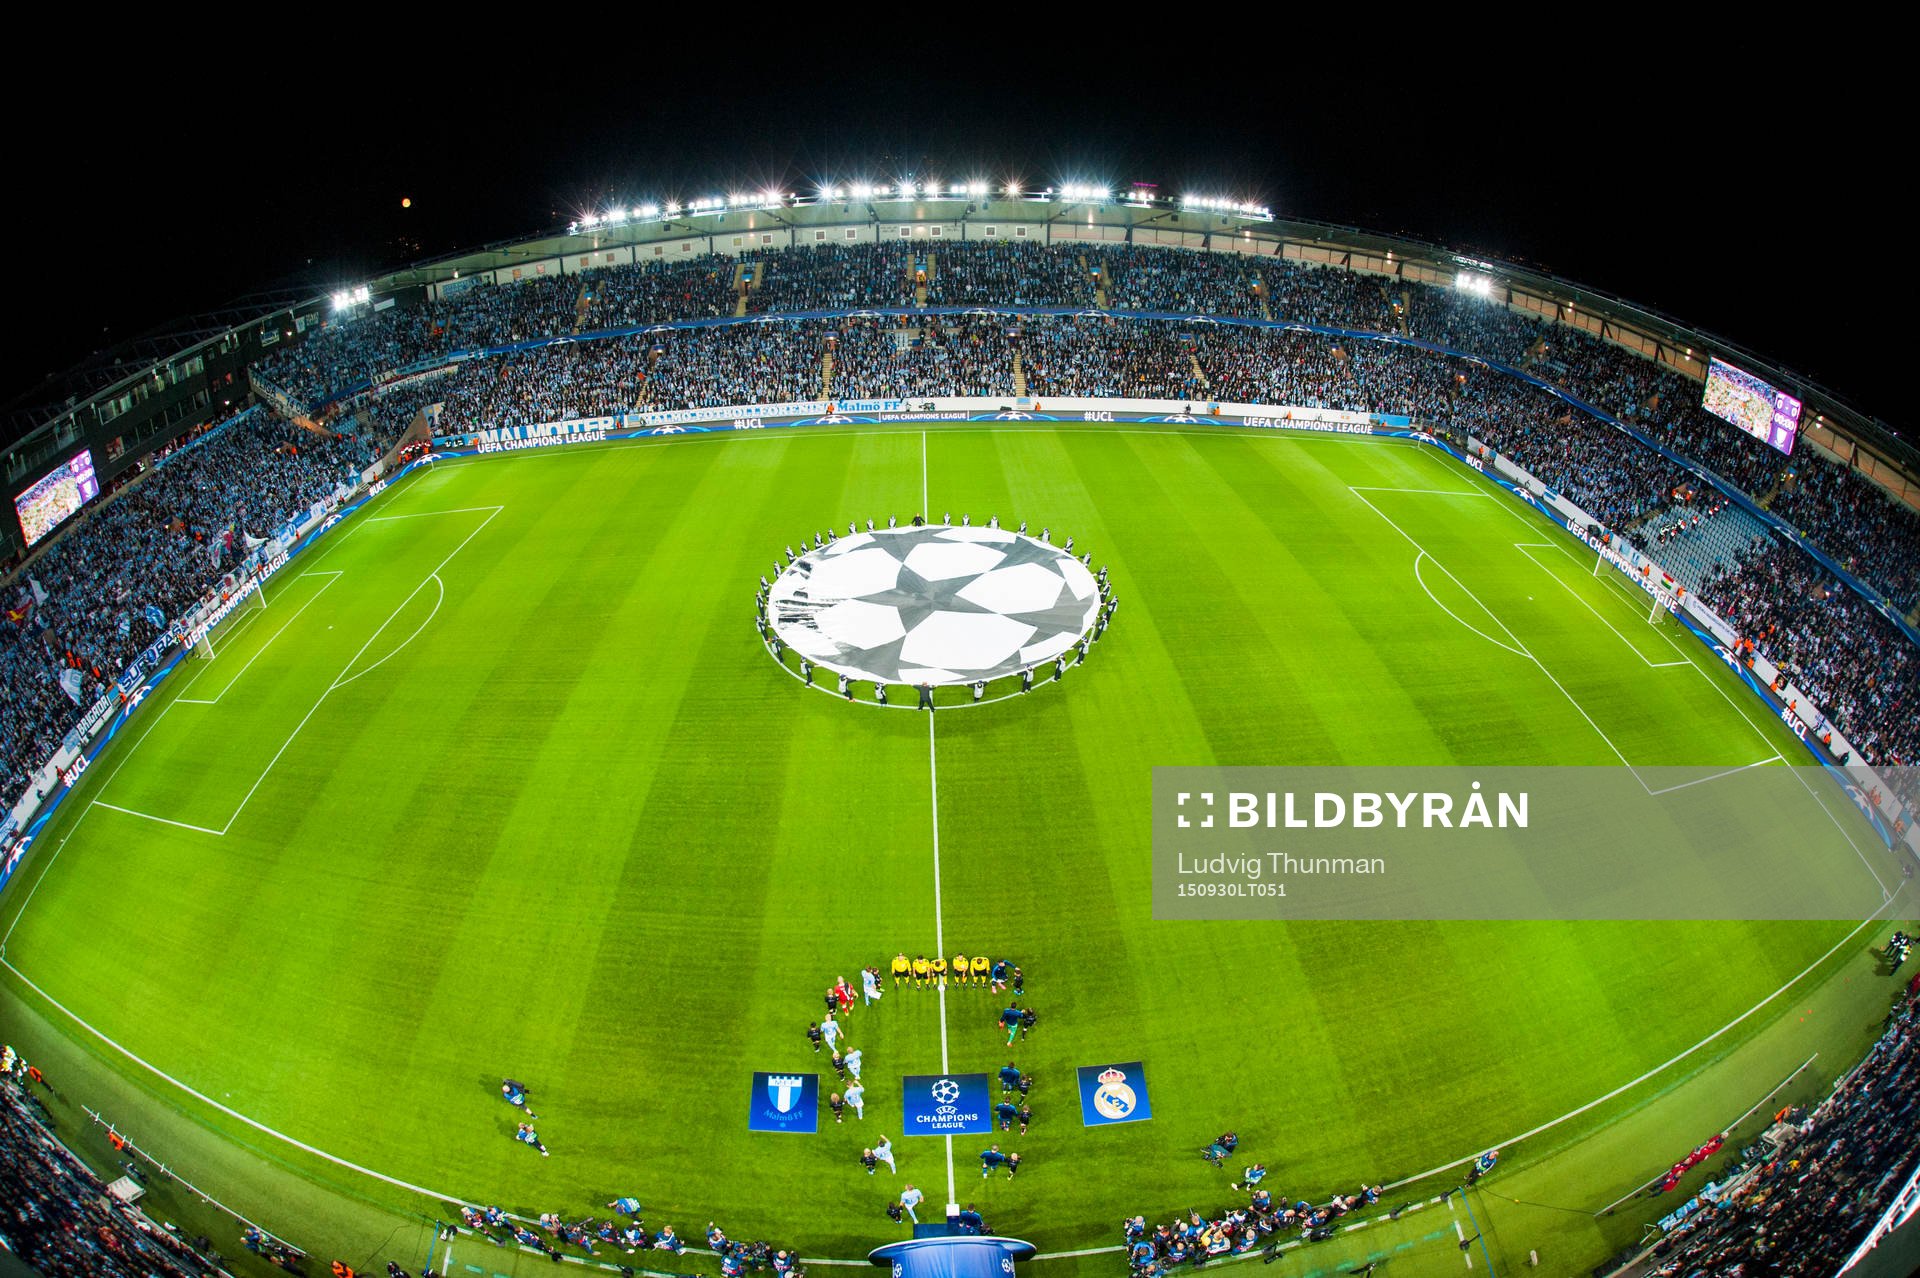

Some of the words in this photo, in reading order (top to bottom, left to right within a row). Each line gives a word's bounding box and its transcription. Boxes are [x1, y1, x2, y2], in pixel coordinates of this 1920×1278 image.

[837, 401, 881, 412] Malmö
[883, 401, 901, 411] FF
[733, 418, 765, 430] #UCL
[881, 413, 899, 421] UEFA
[900, 413, 940, 421] CHAMPIONS
[941, 412, 966, 420] LEAGUE
[1083, 410, 1115, 423] #UCL
[1243, 416, 1272, 429] UEFA
[1274, 418, 1334, 433] CHAMPIONS
[1337, 421, 1373, 435] LEAGUE
[477, 441, 503, 454] UEFA
[504, 435, 563, 452] CHAMPIONS
[565, 430, 606, 444] LEAGUE
[1465, 454, 1484, 473] #UCL
[369, 479, 388, 497] #UCL
[1566, 519, 1588, 543] UEFA
[1589, 536, 1640, 583] CHAMPIONS
[1641, 577, 1678, 613] LEAGUE
[184, 622, 211, 650] UEFA
[211, 576, 259, 624] CHAMPIONS
[259, 549, 291, 583] LEAGUE
[1781, 706, 1808, 742] #UCL
[63, 754, 91, 788] #UCL
[916, 1113, 979, 1123] CHAMPIONS
[936, 1105, 958, 1115] UEFA
